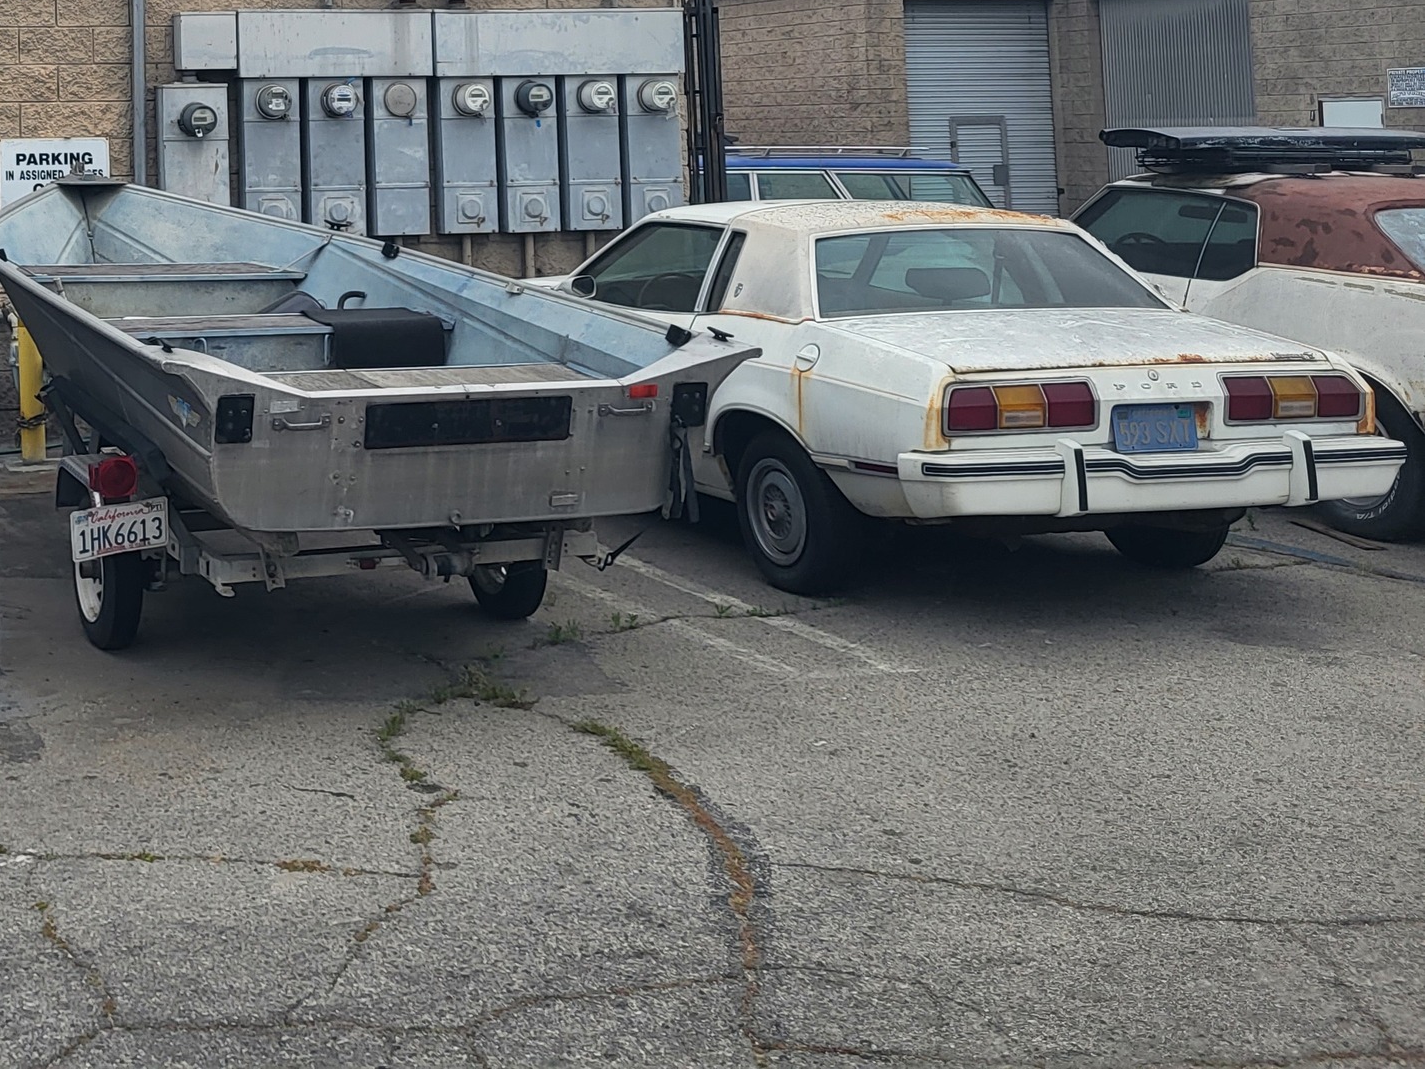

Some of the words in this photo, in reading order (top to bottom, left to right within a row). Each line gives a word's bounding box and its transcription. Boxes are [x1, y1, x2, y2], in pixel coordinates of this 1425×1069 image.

[16, 152, 93, 165] PARKING
[6, 170, 14, 181] IN
[20, 169, 64, 181] ASSIGNED
[1113, 381, 1202, 391] FORD
[1119, 421, 1151, 446] 593
[1156, 420, 1190, 445] SXT
[90, 507, 148, 524] California
[1357, 512, 1375, 520] T/A
[79, 517, 163, 554] 1HK6613
